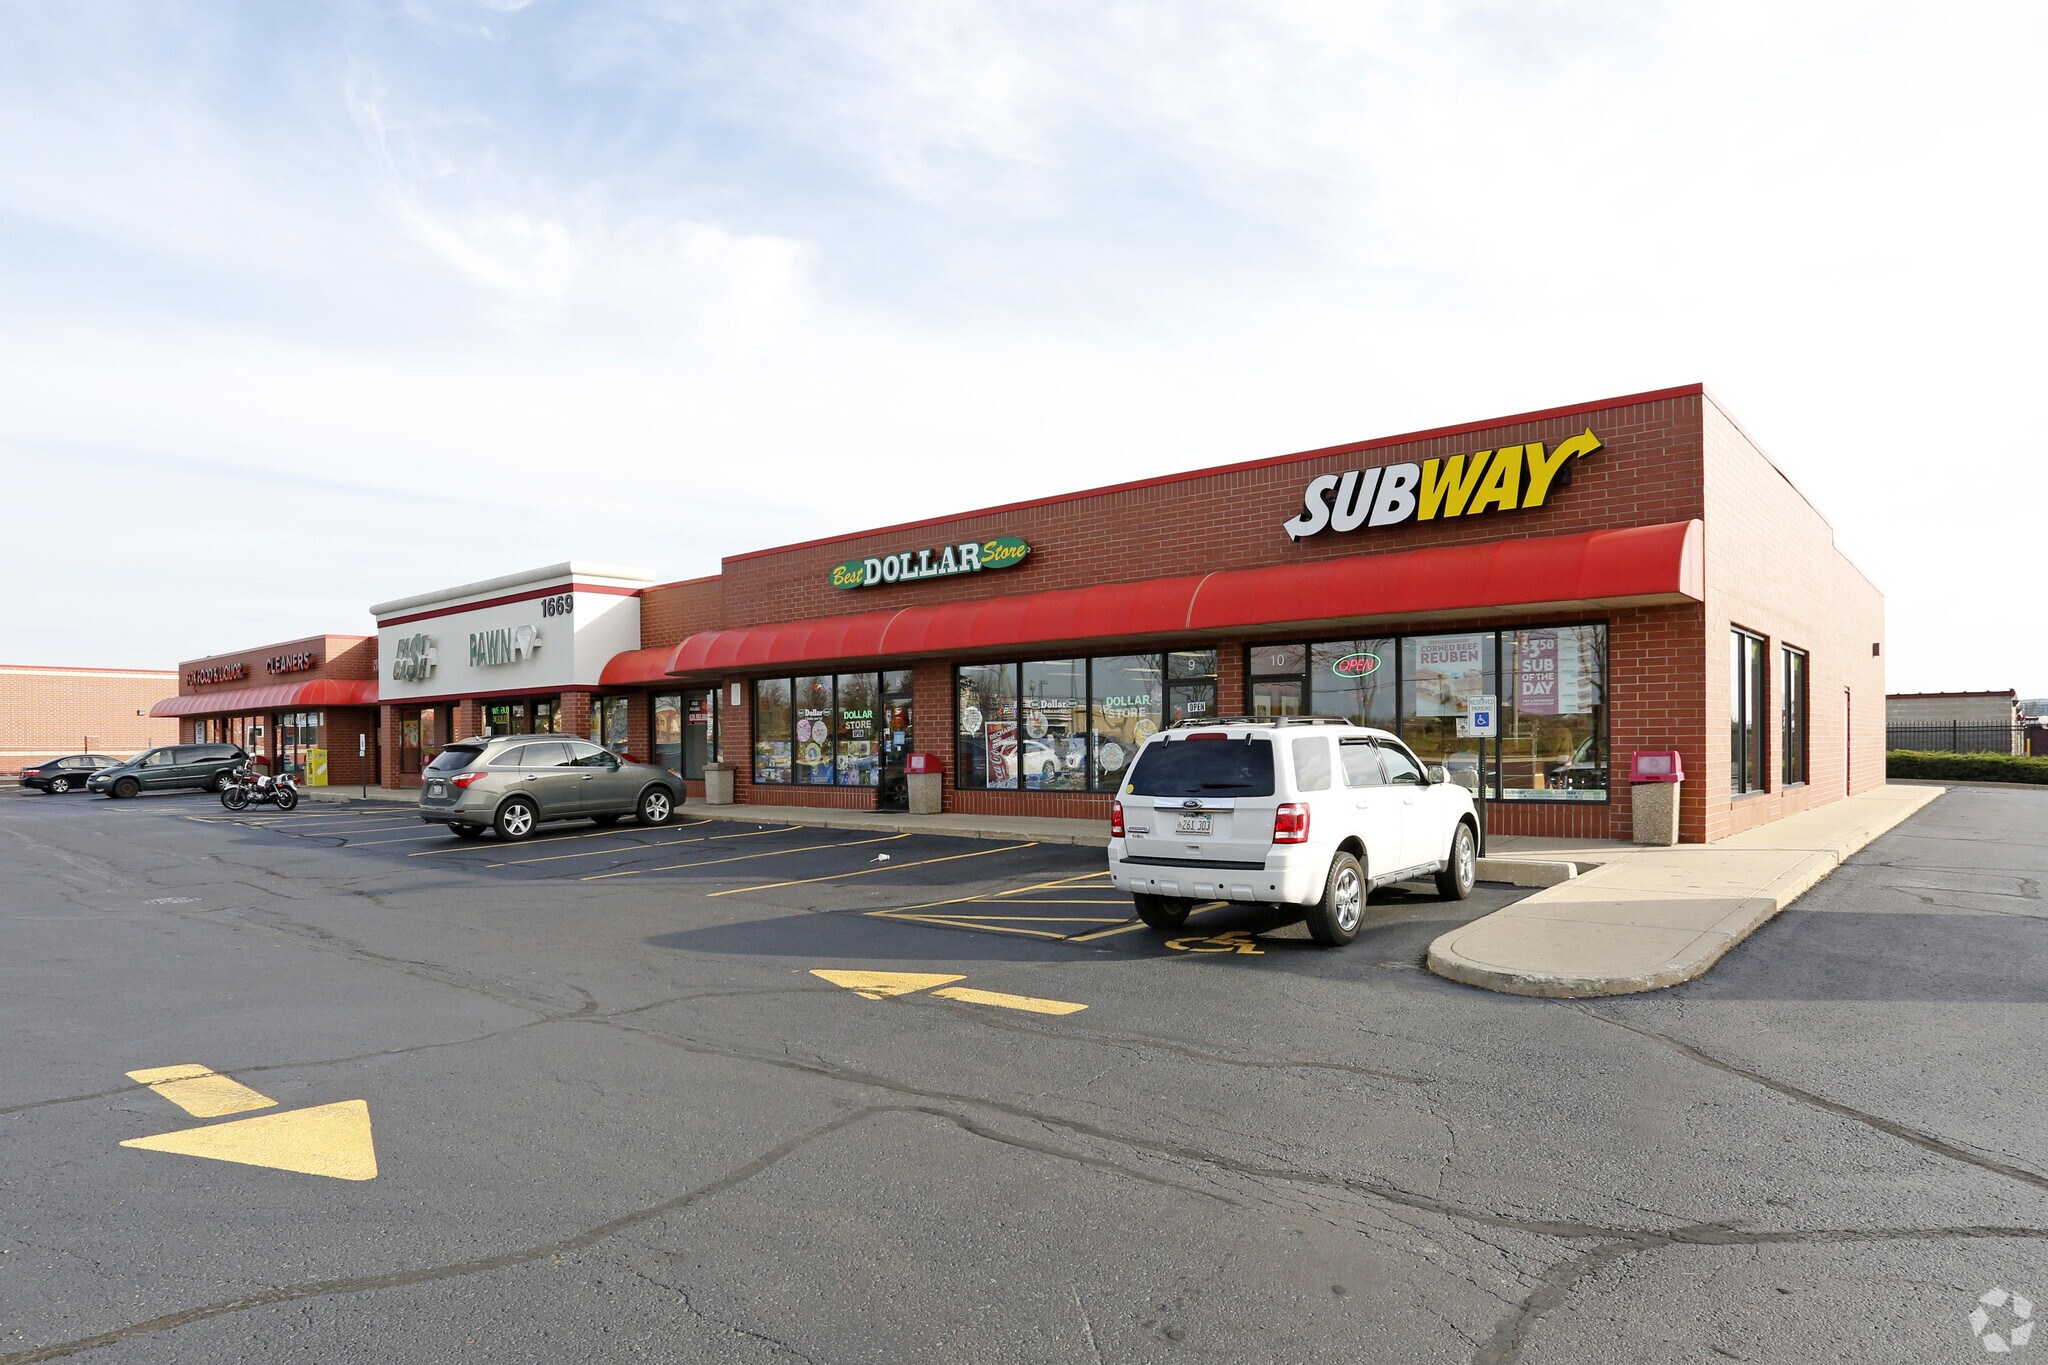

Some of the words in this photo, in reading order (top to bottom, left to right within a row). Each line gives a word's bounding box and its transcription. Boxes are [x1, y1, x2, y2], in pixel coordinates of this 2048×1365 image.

[1283, 427, 1601, 540] SUBWAY
[833, 565, 863, 586] Best
[863, 543, 982, 585] DOLLAR
[980, 541, 1025, 563] Store
[541, 594, 574, 618] 1669
[469, 628, 516, 668] PAWN
[1420, 644, 1455, 652] CORNED
[1456, 642, 1478, 651] BEEF
[265, 651, 311, 675] CLEANERS
[1270, 654, 1285, 667] 10
[1420, 650, 1478, 664] REUBEN
[1188, 659, 1195, 671] 9
[1338, 658, 1375, 672] OPEN
[1522, 658, 1555, 673] SUB
[895, 677, 901, 687] 8
[1522, 673, 1535, 681] OF
[1535, 672, 1555, 681] THE
[1522, 681, 1555, 696] DAY
[1040, 699, 1066, 708] Dollar
[1106, 694, 1151, 707] DOLLAR
[804, 708, 823, 717] Dollar
[1107, 707, 1146, 719] STORE
[1188, 702, 1205, 712] OPEN
[843, 709, 873, 720] DOLLAR
[845, 720, 872, 730] STORE
[853, 730, 864, 738] OPEN
[1182, 819, 1194, 831] 261
[1198, 820, 1211, 831] 303
